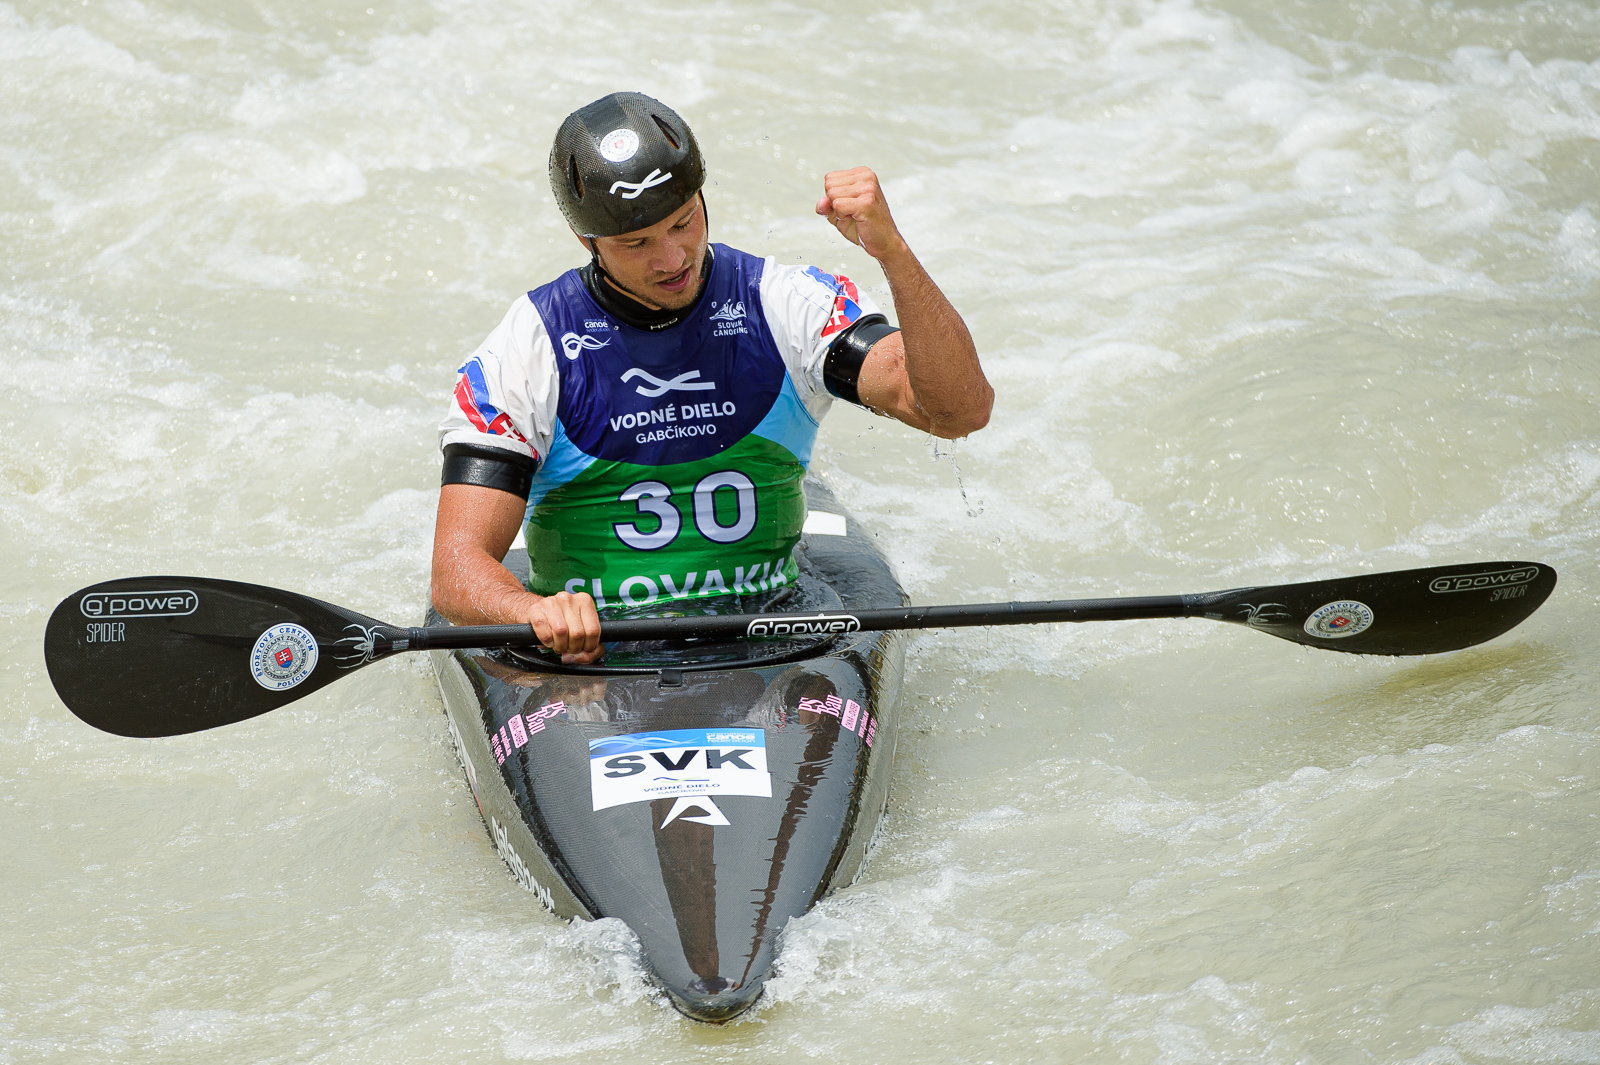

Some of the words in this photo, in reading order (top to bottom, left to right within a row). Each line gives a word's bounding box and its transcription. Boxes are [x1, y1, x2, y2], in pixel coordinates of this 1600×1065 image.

[584, 321, 609, 329] canoe
[713, 327, 748, 337] CANOEING
[717, 320, 743, 329] SLOVAK
[609, 403, 677, 432] VODNÉ
[682, 401, 736, 420] DIELO
[635, 423, 717, 444] GABČÍKOVO
[612, 469, 758, 551] 30
[1490, 584, 1528, 602] SPIDER
[85, 596, 194, 615] g'power
[86, 622, 126, 643] SPIDER
[279, 627, 314, 652] CENTRUM
[816, 694, 843, 718] Bau
[525, 709, 546, 736] Bau
[603, 749, 757, 779] SVK
[643, 784, 683, 792] VODNÉ
